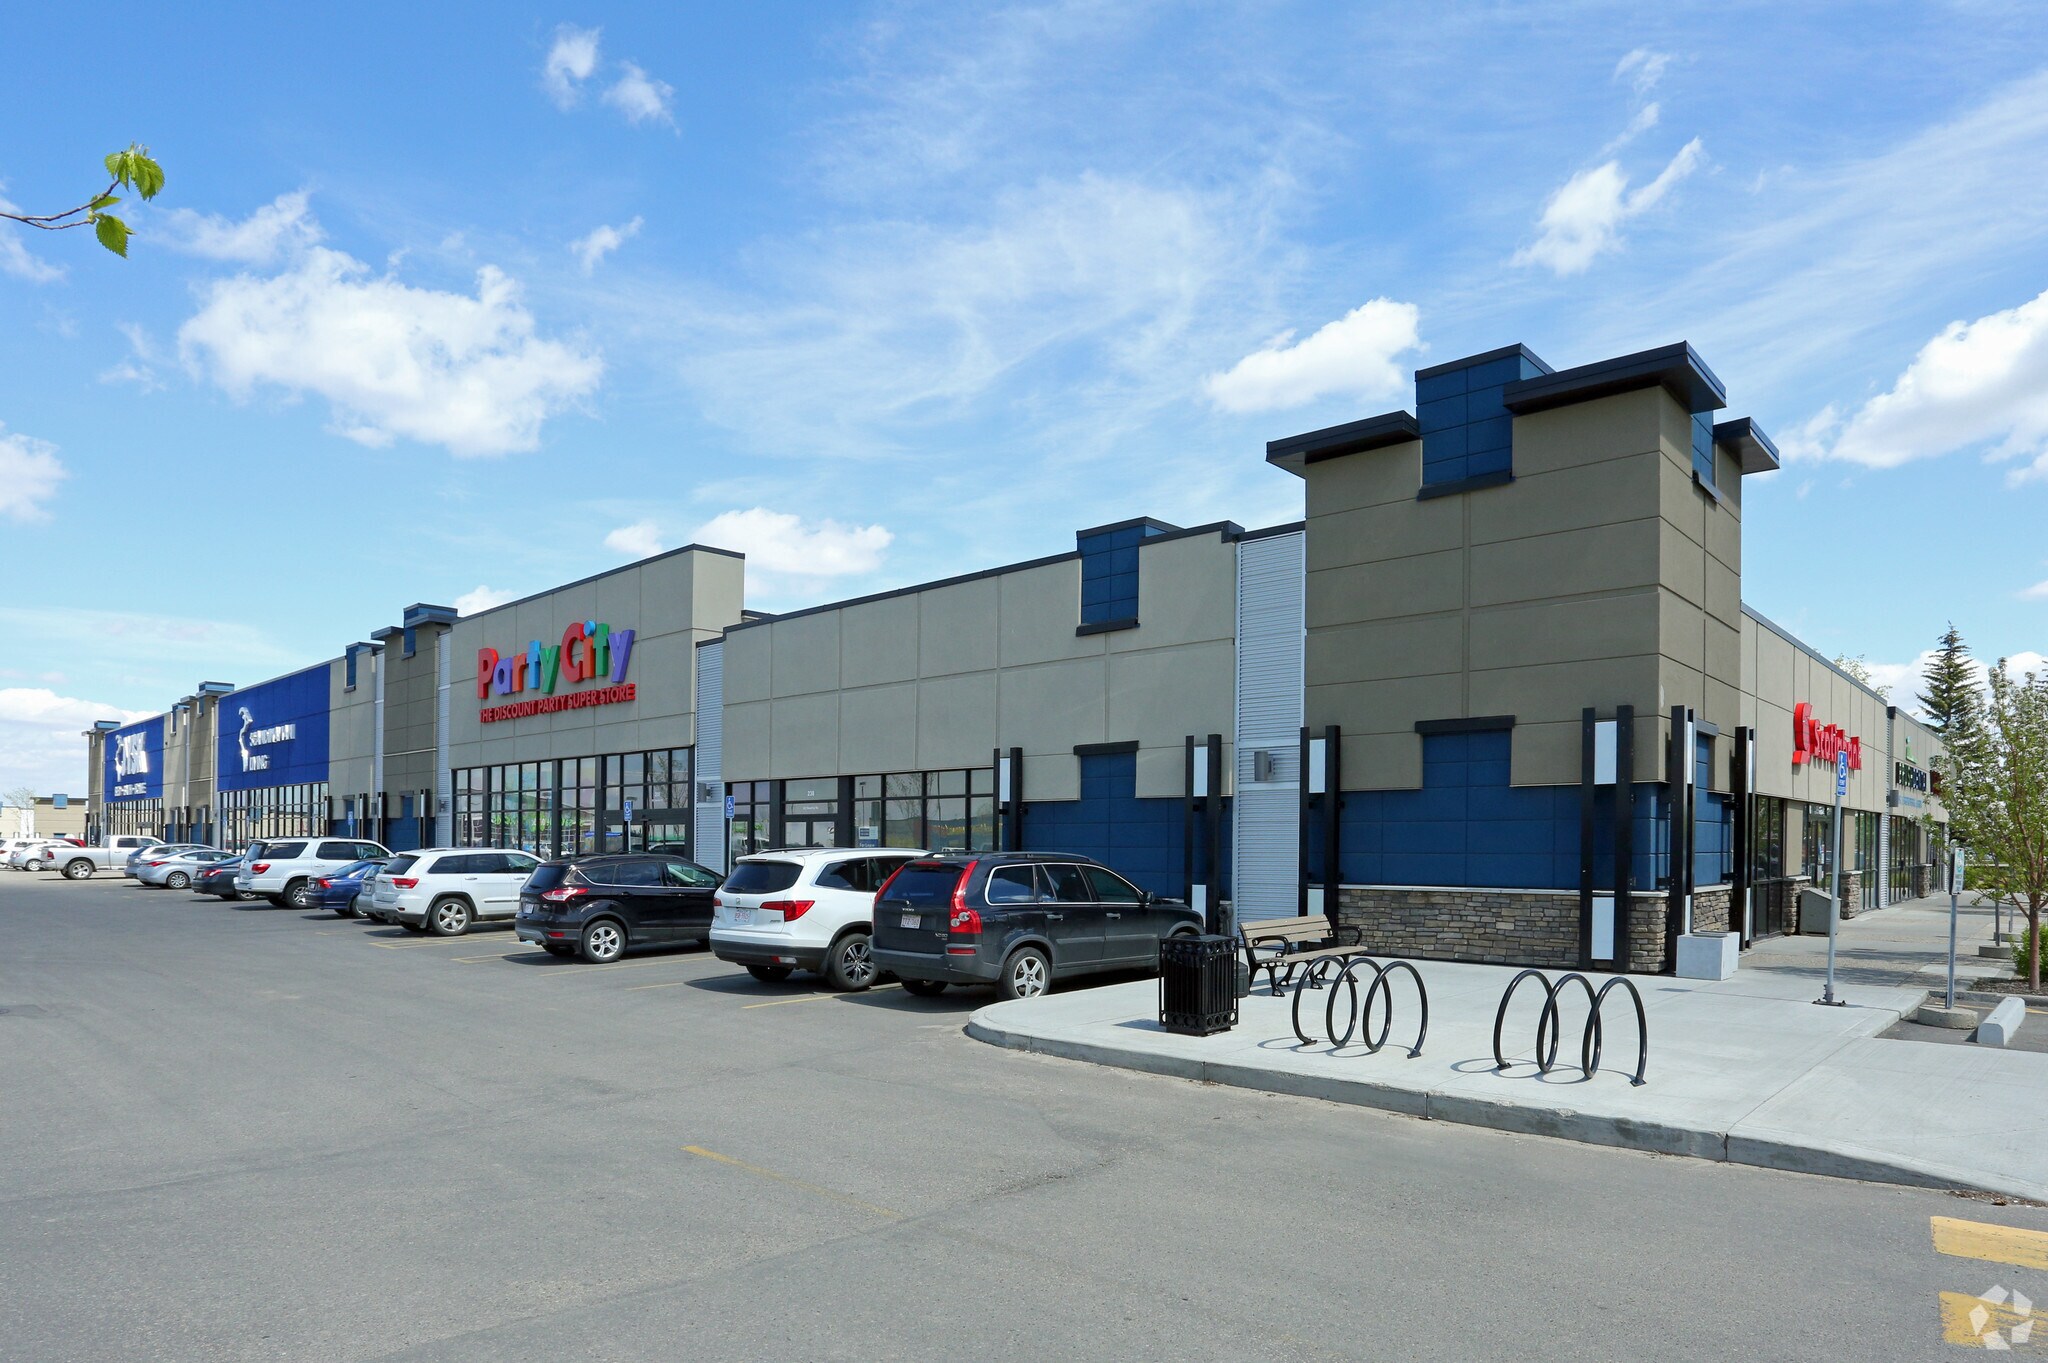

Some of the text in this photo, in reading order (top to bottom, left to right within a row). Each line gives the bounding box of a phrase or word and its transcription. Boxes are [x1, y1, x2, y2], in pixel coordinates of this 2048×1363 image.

[477, 620, 636, 699] Party City
[479, 683, 636, 723] THE DISCOUNT PARTY SUPER STORE
